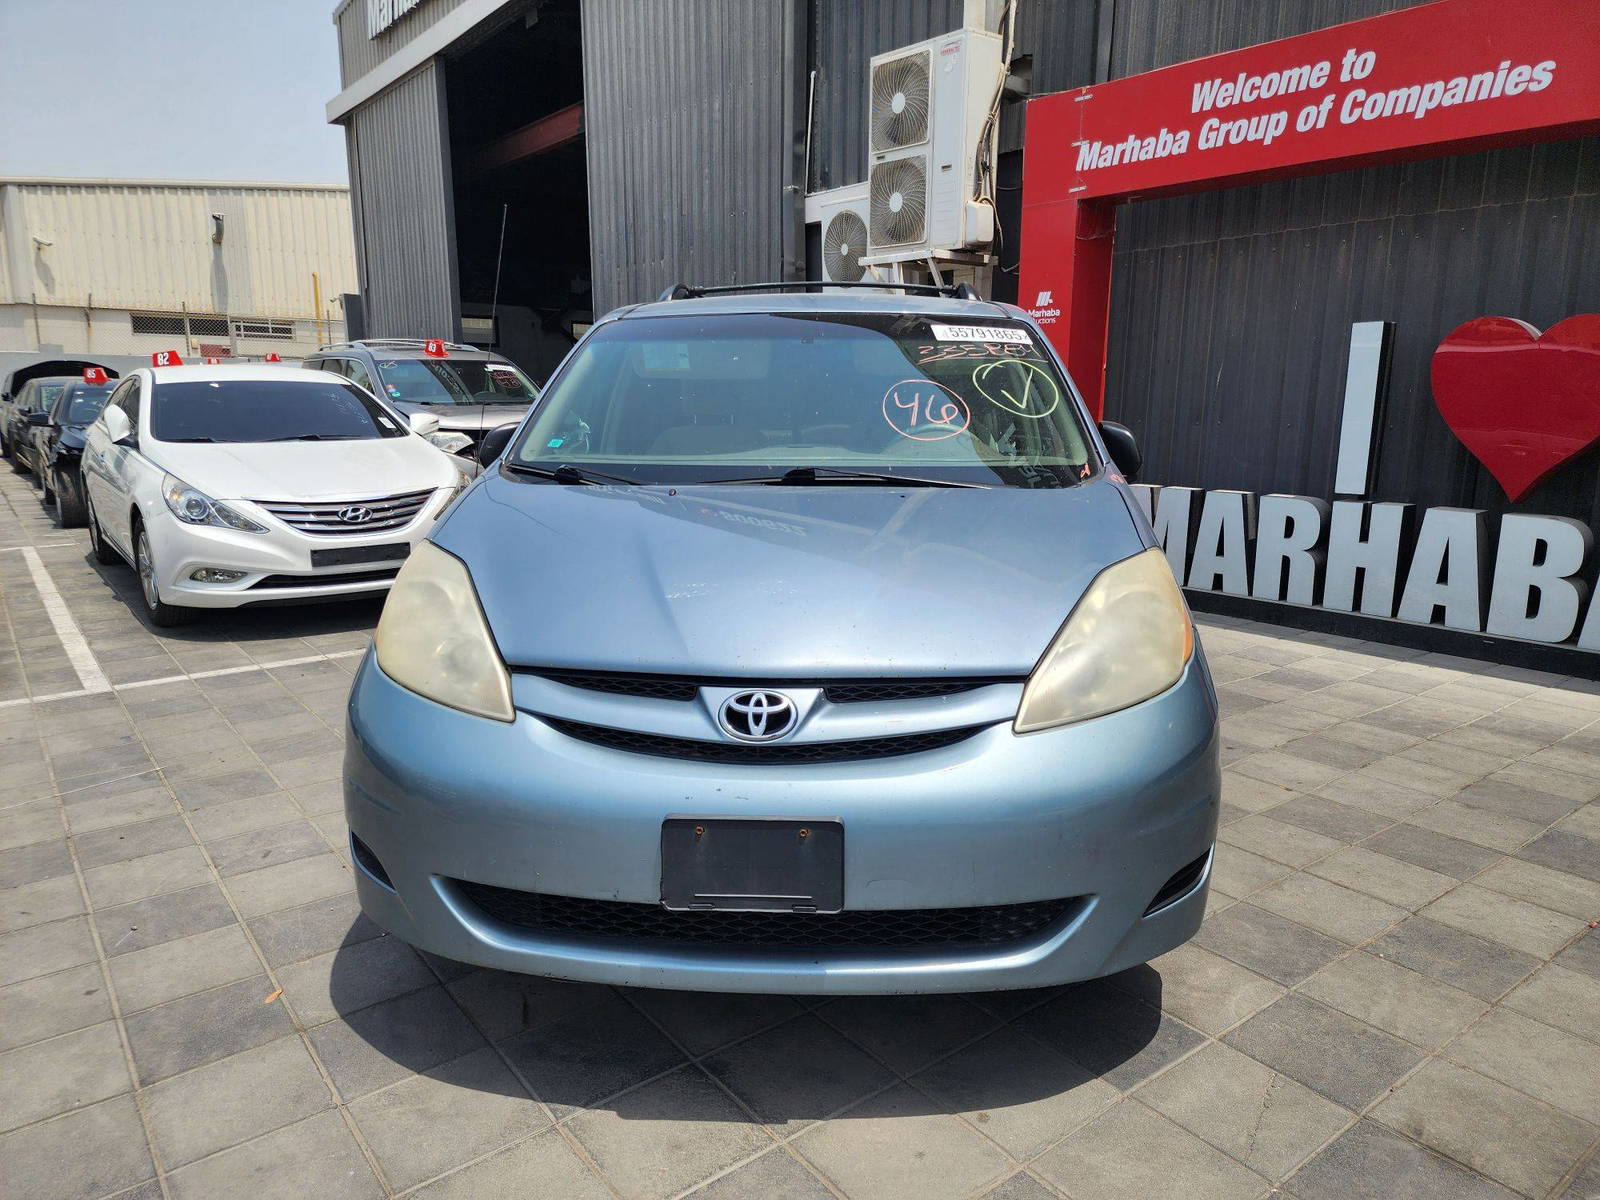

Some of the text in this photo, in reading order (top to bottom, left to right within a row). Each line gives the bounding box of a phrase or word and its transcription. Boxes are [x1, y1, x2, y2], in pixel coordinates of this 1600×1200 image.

[1191, 47, 1377, 114] Welcome to
[1075, 60, 1557, 171] Marhaba Group of Companies
[1028, 308, 1061, 318] Marhaba
[1033, 317, 1056, 325] uctions
[157, 352, 170, 365] 82
[894, 391, 959, 426] 46
[1335, 321, 1385, 495] I
[1128, 484, 1600, 650] MARHAB
